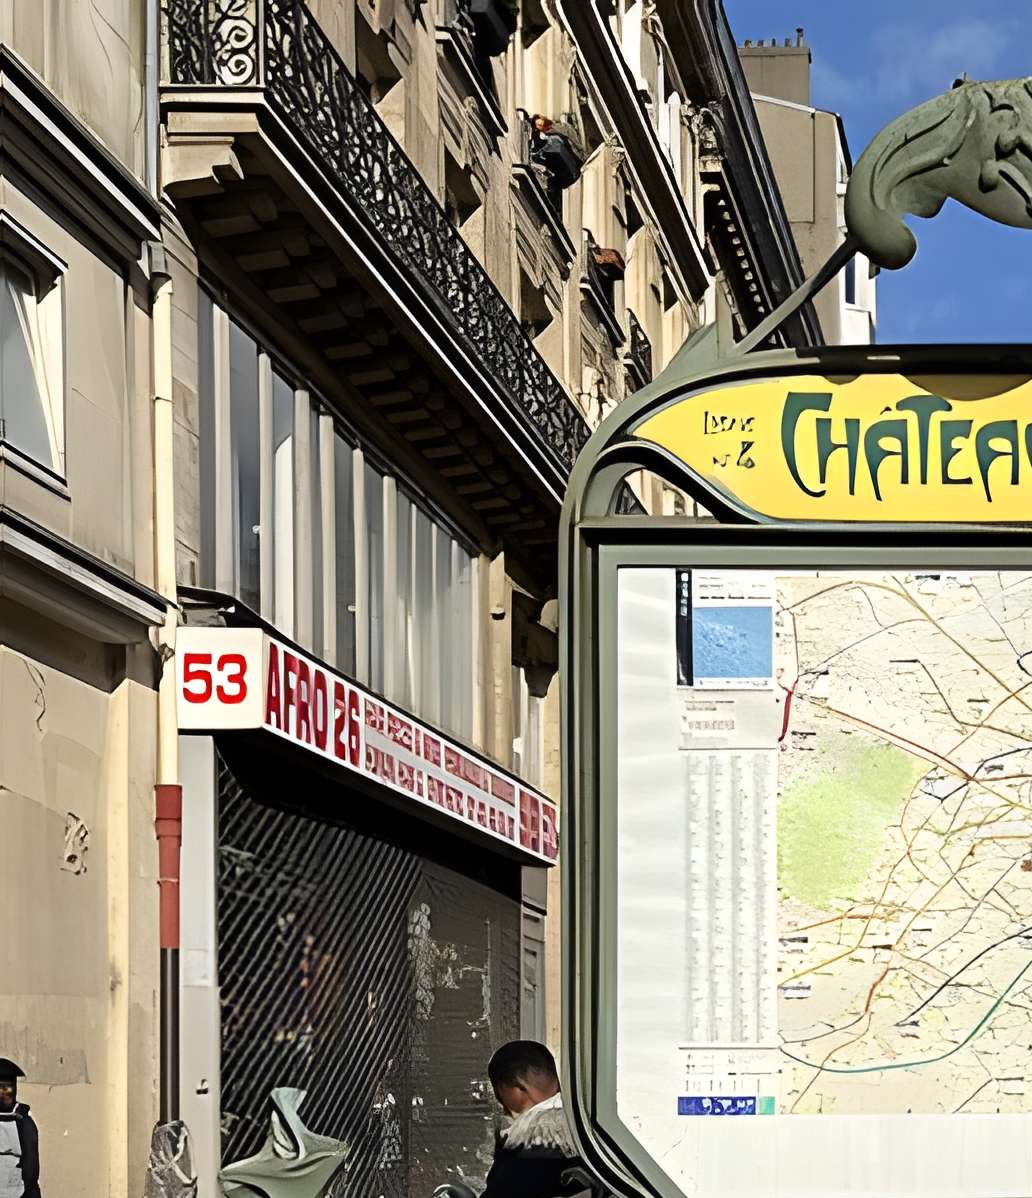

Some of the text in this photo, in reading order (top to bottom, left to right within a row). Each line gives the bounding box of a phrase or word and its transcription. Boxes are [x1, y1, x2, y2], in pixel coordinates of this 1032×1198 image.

[183, 653, 247, 704] 53
[265, 642, 328, 752] AFRO
[334, 680, 361, 769] 26
